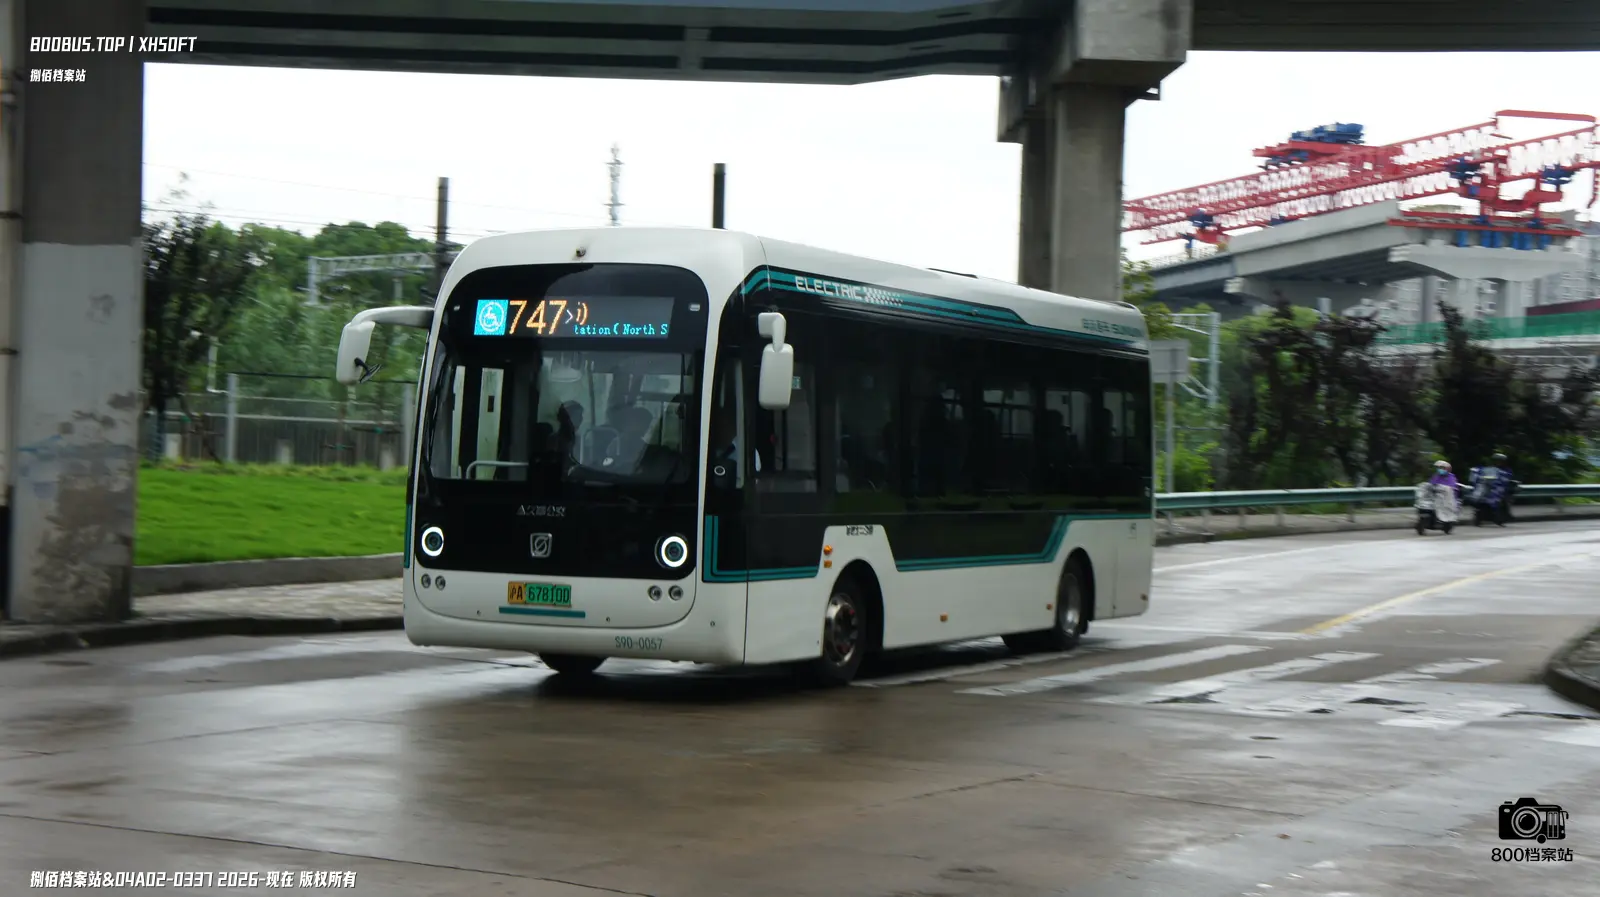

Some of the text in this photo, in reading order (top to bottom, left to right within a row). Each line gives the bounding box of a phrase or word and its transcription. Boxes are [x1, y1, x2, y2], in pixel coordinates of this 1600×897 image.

[795, 276, 863, 301] ELECTRIC
[509, 300, 568, 335] 747
[622, 323, 655, 335] North
